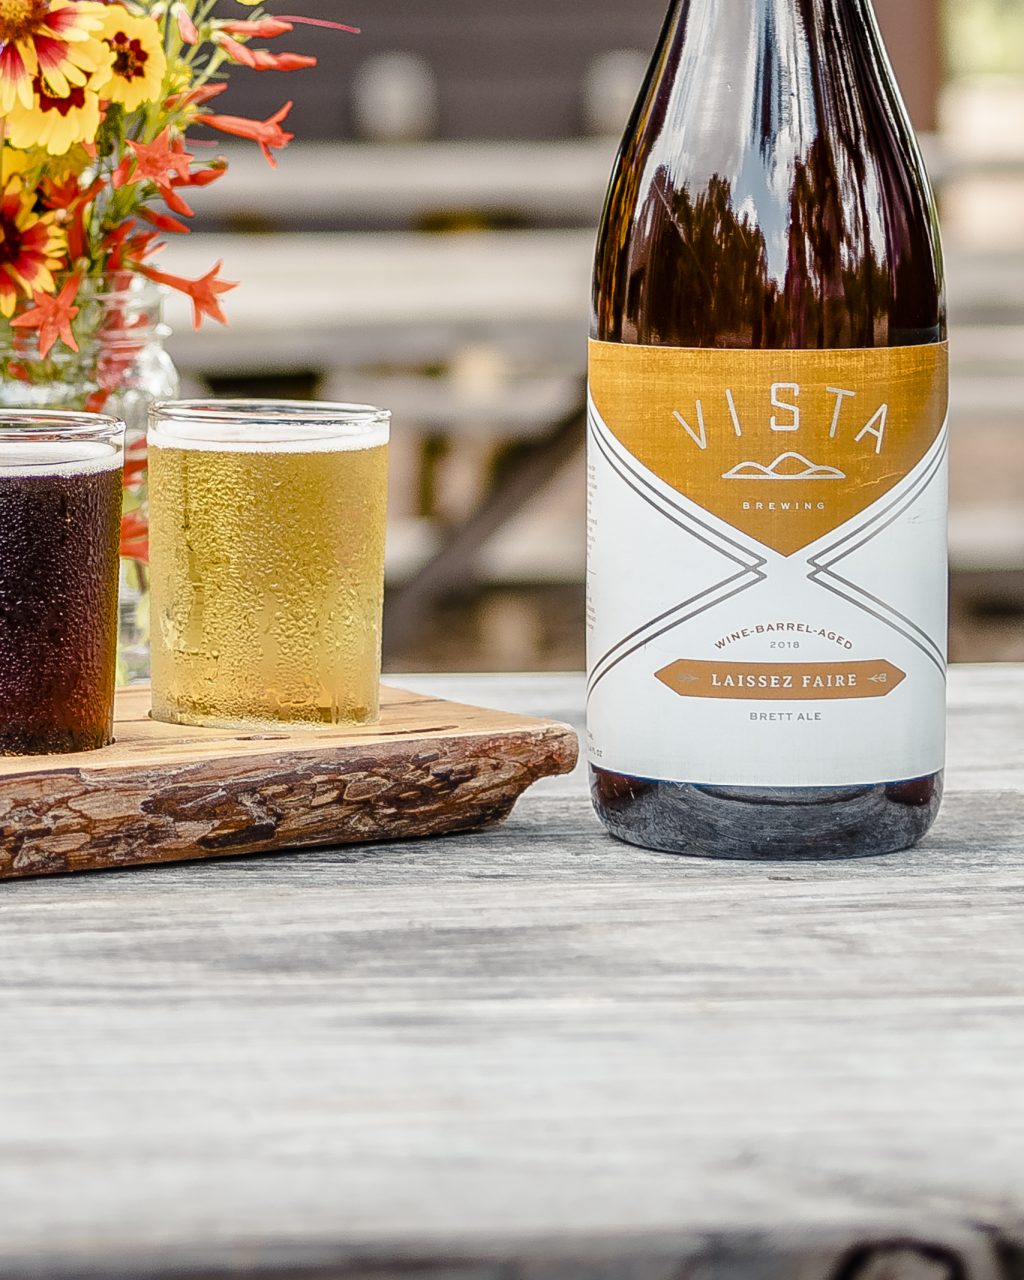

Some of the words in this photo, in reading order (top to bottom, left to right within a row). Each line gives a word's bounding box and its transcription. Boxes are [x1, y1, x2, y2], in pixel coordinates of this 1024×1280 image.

[672, 382, 888, 455] VISTA
[742, 501, 825, 510] BREWING
[714, 622, 853, 650] WINE-BARREL-AGED
[770, 641, 800, 649] 2018
[711, 673, 793, 688] LAISSEZ
[802, 673, 857, 688] FAIRE
[749, 712, 793, 721] BRETT
[797, 712, 822, 721] ALE
